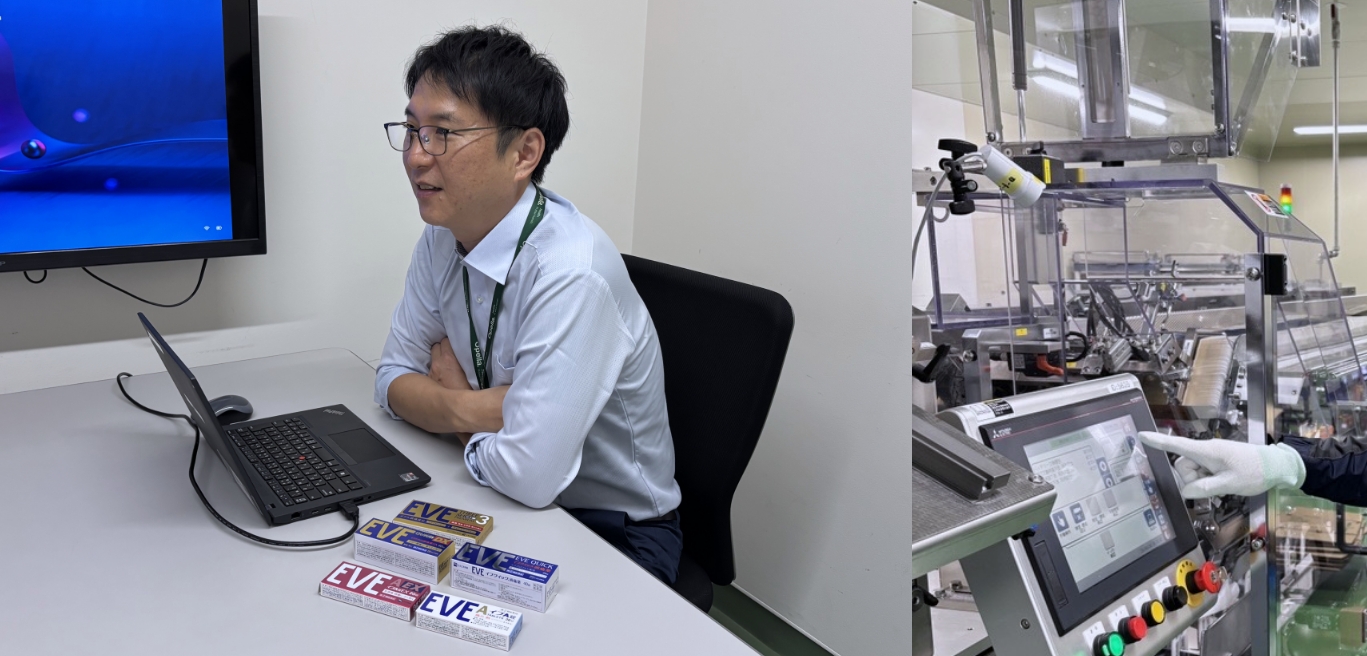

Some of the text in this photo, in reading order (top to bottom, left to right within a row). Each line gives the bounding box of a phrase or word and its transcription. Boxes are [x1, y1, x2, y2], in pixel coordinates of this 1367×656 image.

[403, 501, 458, 523] EVE
[475, 515, 490, 525] 3
[359, 519, 416, 545] EVE
[434, 536, 451, 545] DX
[456, 543, 516, 572] EVE
[515, 555, 554, 570] EVE QUICK
[326, 562, 393, 596] EVE
[471, 566, 485, 577] EVE
[419, 592, 480, 622] EVE
[476, 605, 488, 615] A
